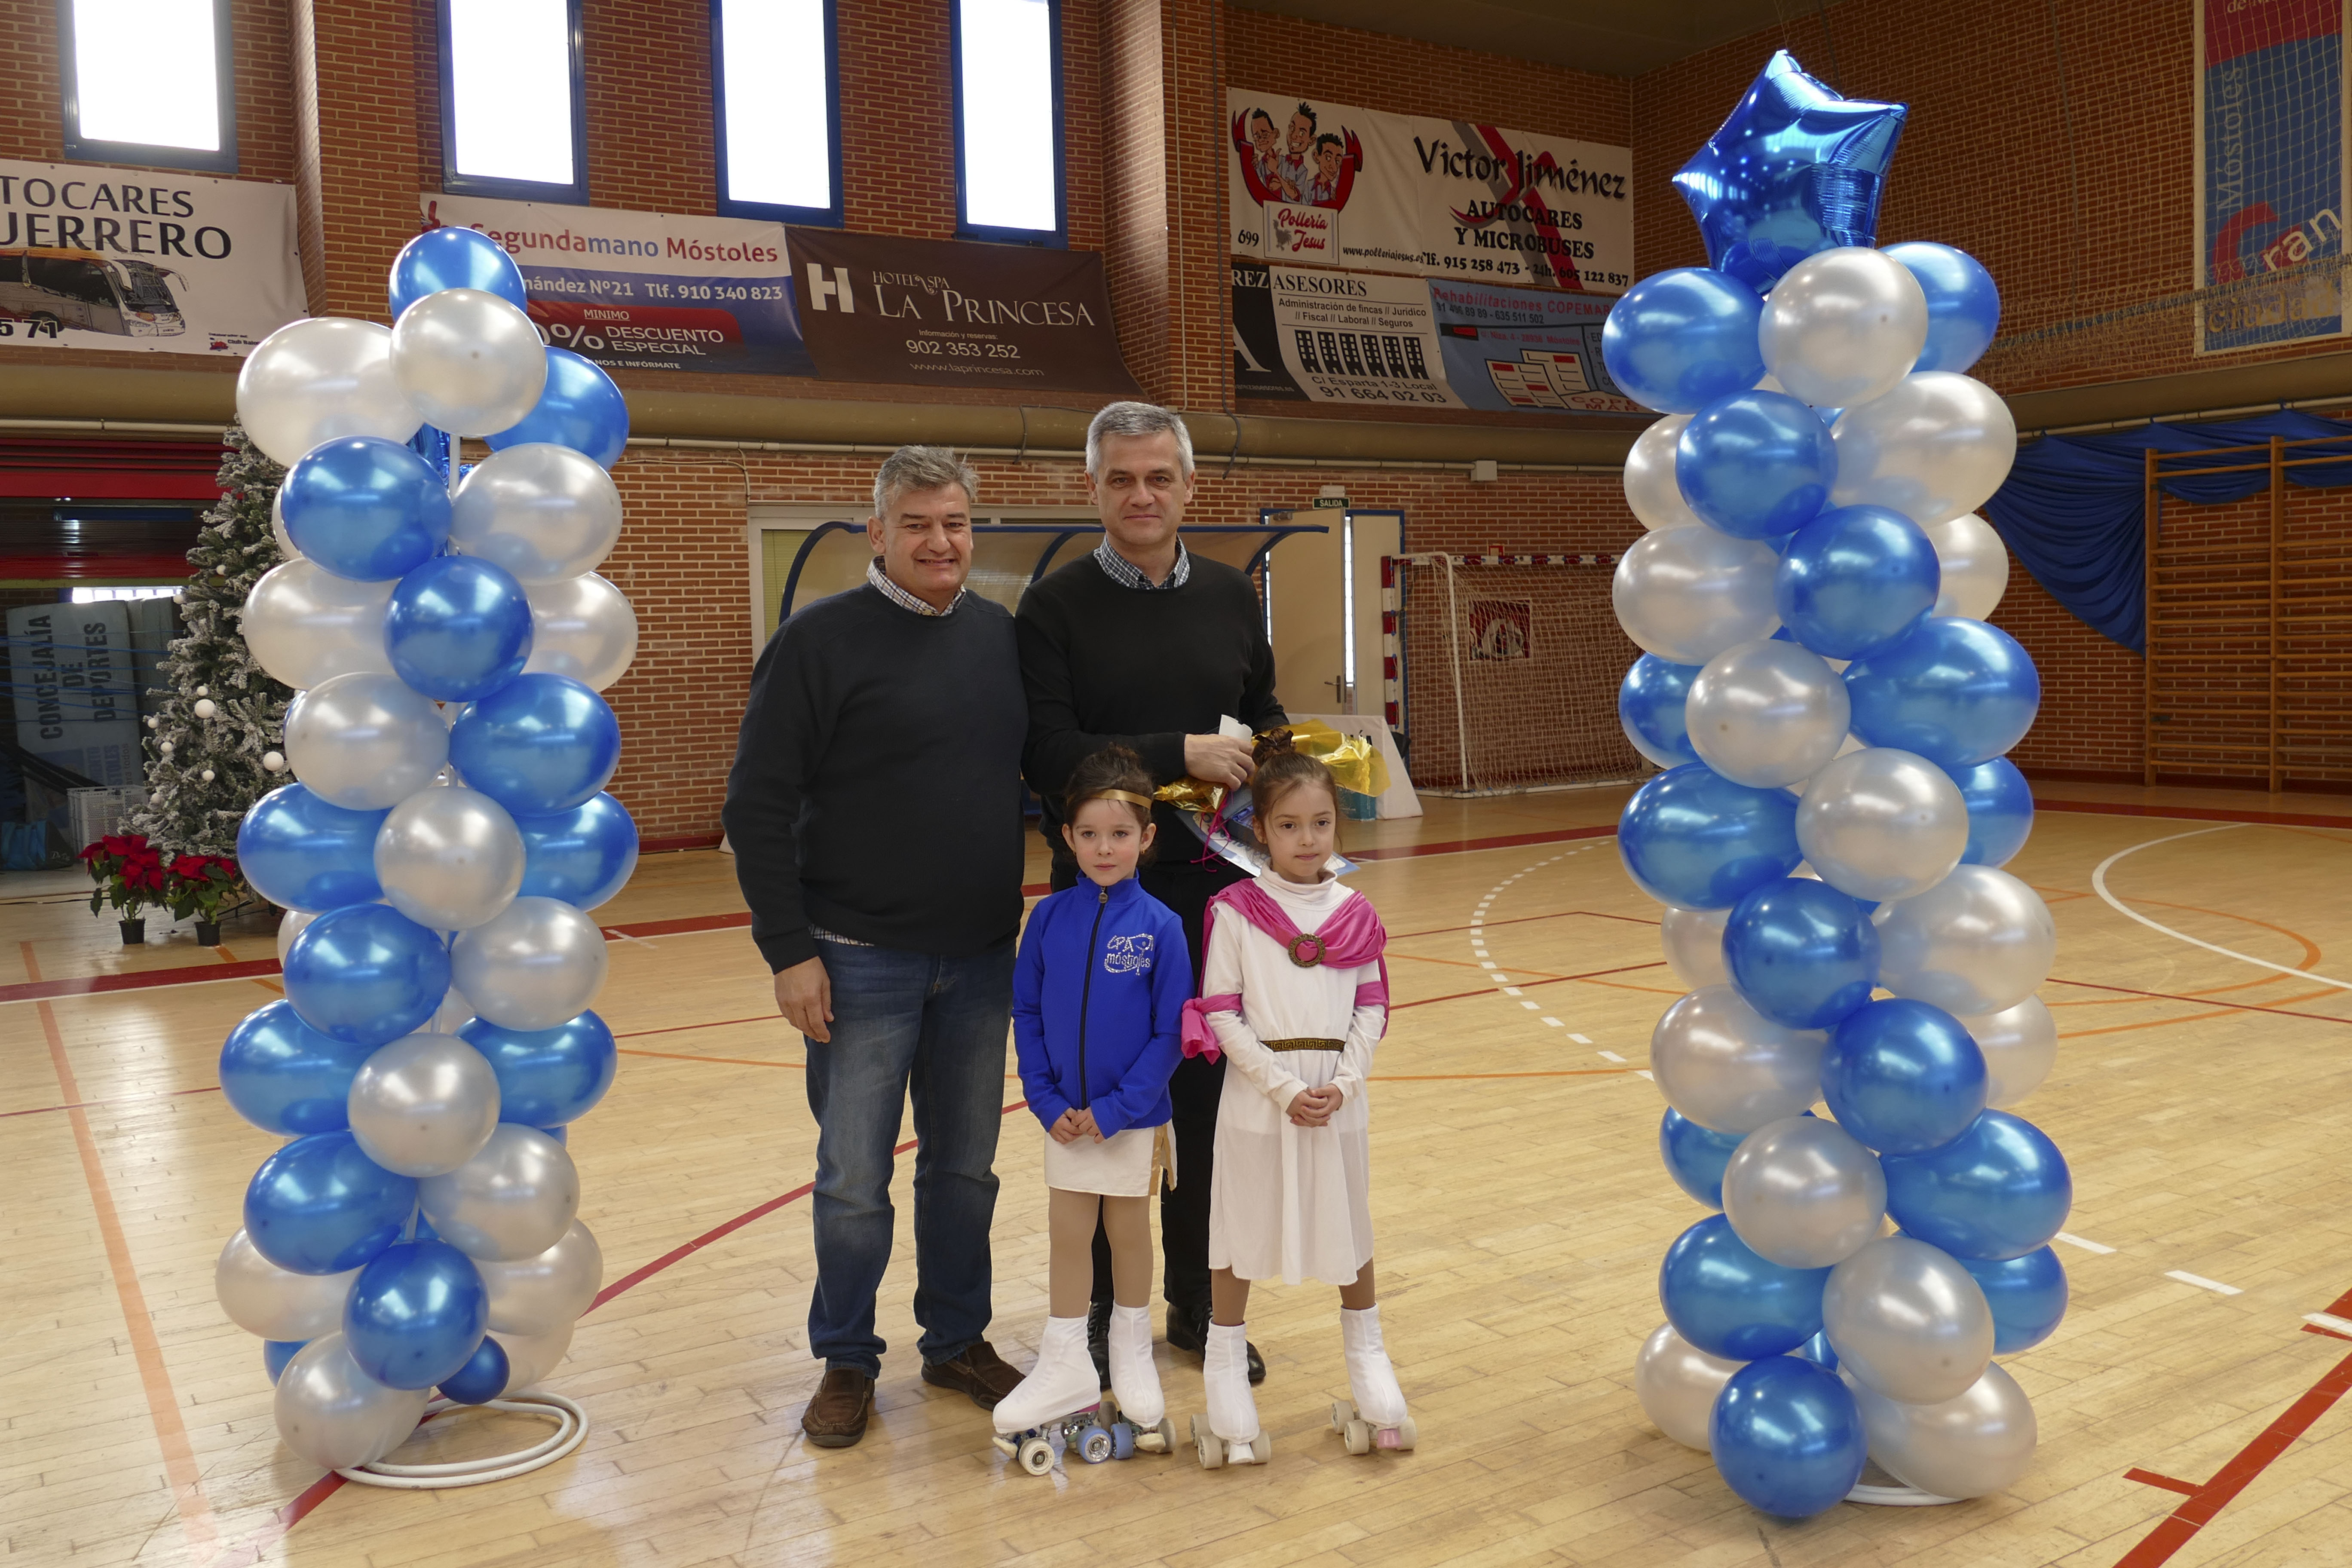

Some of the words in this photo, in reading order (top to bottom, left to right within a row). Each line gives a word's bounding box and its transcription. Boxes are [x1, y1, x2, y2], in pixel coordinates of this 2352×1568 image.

[2215, 67, 2243, 211] Móstoles
[1515, 150, 1626, 199] Jiménez
[1467, 199, 1583, 230] AUTOCARES
[1238, 230, 1259, 247] 699
[1455, 227, 1468, 245] Y
[1474, 229, 1595, 259] MICROBUSES
[667, 237, 778, 263] Móstoles
[873, 271, 918, 287] HOTEL
[927, 276, 950, 289] SPA
[1444, 256, 1467, 270] 915
[1471, 259, 1493, 271] 258
[1497, 261, 1520, 275] 473
[1559, 267, 1580, 280] 605
[1584, 271, 1605, 283] 122
[1608, 273, 1628, 287] 837
[590, 279, 634, 296] Nº21
[645, 283, 674, 298] Tlf.
[678, 285, 710, 300] 910
[714, 286, 747, 300] 340
[751, 286, 782, 300] 823
[1273, 274, 1367, 297] ASESORES
[873, 284, 922, 319] LA
[942, 289, 1095, 326] PRINCESA
[1279, 298, 1344, 311] Administración
[1346, 302, 1357, 312] de
[1359, 304, 1383, 314] fincas
[1433, 287, 1542, 312] Rehabilitaciones
[1547, 300, 1611, 316] COPEMAR
[2208, 279, 2334, 332] ciudad
[584, 309, 630, 320] MINIMO
[1303, 312, 1328, 322] Fiscal
[1338, 314, 1369, 325] Laboral
[1378, 318, 1413, 329] Seguros
[1436, 302, 1446, 312] 91
[1465, 306, 1475, 317] 89
[1478, 309, 1488, 318] 89
[1495, 310, 1510, 321] 635
[1513, 312, 1526, 322] 511
[1529, 314, 1544, 324] 502
[22, 318, 58, 339] 71
[605, 326, 724, 343] DESCUENTO
[919, 329, 959, 338] Información
[611, 340, 706, 355] ESPECIAL
[906, 340, 942, 355] 902
[946, 342, 981, 356] 353
[985, 344, 1021, 358] 252
[625, 360, 681, 369] INFÓRMATE
[910, 363, 1045, 376] www.laprincesa.com
[1312, 376, 1326, 384] C/
[1330, 377, 1378, 388] Esparta
[1381, 380, 1400, 389] 1-3
[1403, 382, 1437, 390] Local
[1320, 386, 1346, 398] 91
[1351, 388, 1389, 400] 664
[1391, 390, 1419, 402] 02
[1421, 392, 1447, 404] 03
[1585, 404, 1638, 412] MAR
[24, 615, 63, 739] CONCEJALÍA
[61, 662, 85, 687] DE
[84, 622, 116, 723] DEPORTES
